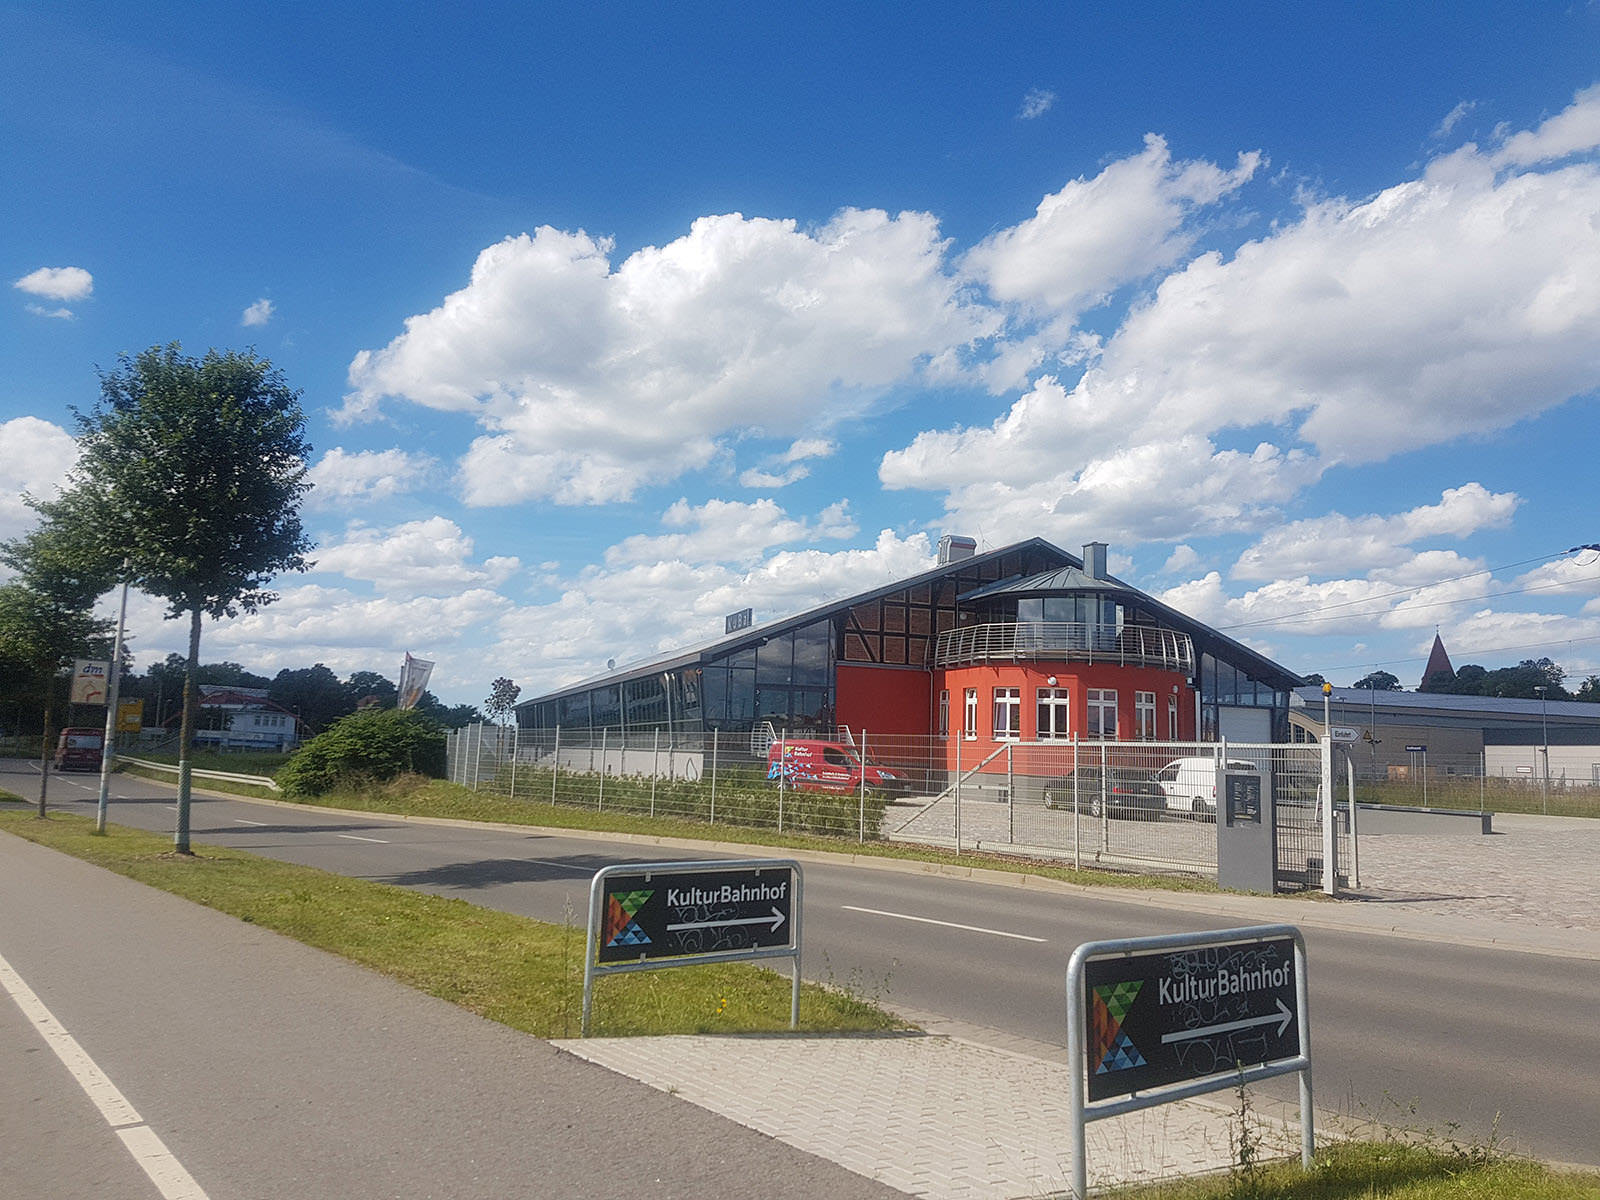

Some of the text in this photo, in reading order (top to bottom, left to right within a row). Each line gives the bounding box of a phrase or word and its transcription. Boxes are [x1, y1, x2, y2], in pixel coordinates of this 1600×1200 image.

[83, 663, 103, 674] dm
[667, 882, 787, 907] KulturBahnhof
[1158, 960, 1290, 1005] KulturBahnhof
